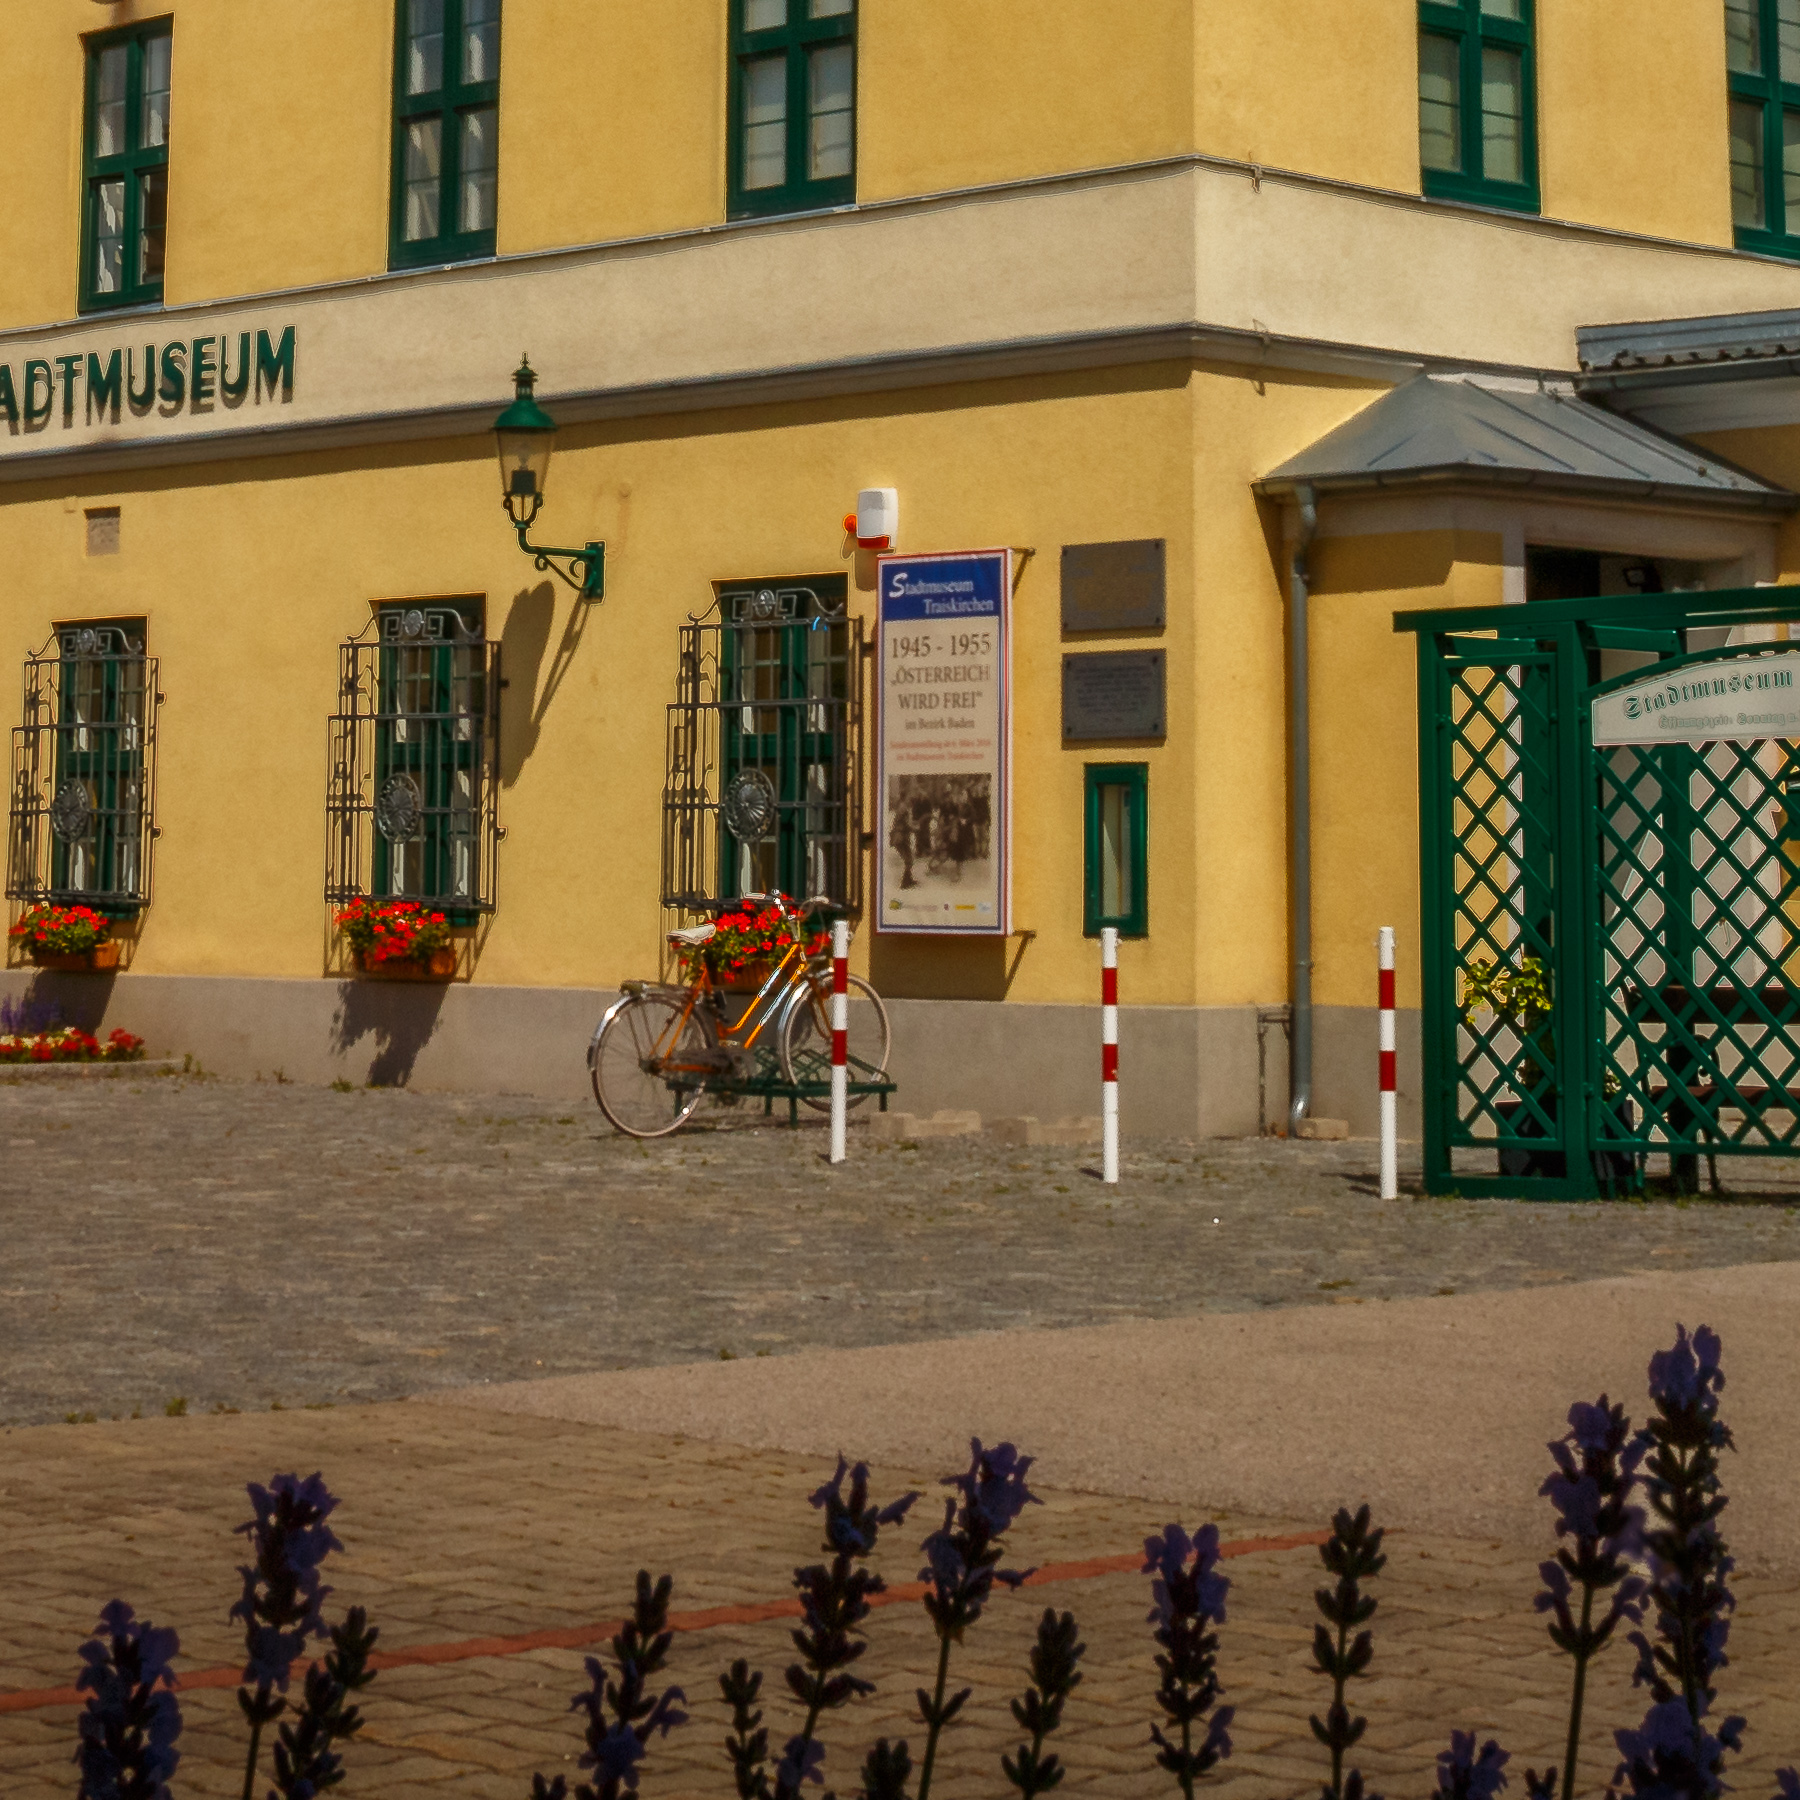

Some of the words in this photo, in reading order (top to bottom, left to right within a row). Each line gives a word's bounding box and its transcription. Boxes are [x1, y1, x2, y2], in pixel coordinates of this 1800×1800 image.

[888, 572, 974, 599] Stadtmuseum
[922, 597, 995, 615] Traiskirchen
[892, 635, 932, 659] 1945
[950, 632, 992, 656] 1955
[897, 692, 940, 710] WIRD
[1623, 670, 1793, 720] Stadtmuseum
